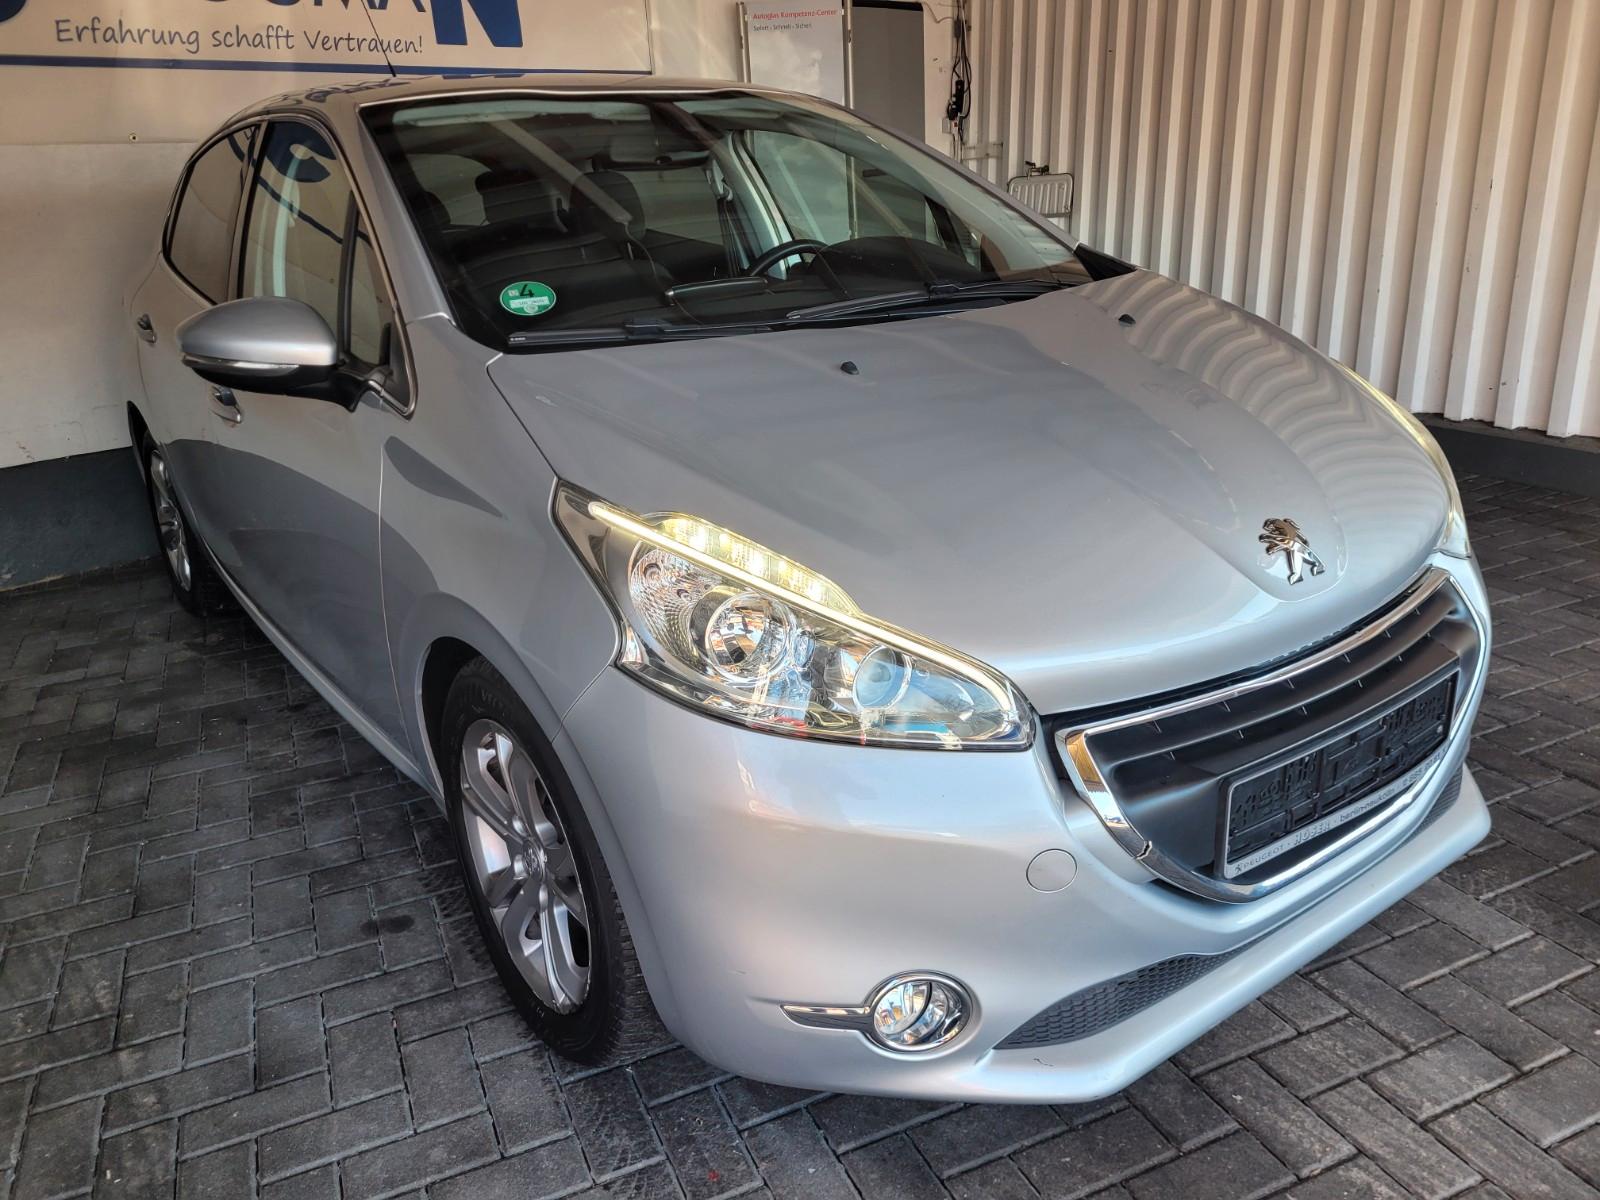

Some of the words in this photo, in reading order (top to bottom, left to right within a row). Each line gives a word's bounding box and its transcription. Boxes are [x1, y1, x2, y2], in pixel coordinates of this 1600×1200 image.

[55, 18, 201, 54] Erfahrung
[211, 24, 296, 50] schafft
[303, 29, 425, 55] Vertrauen!
[519, 283, 535, 298] 4
